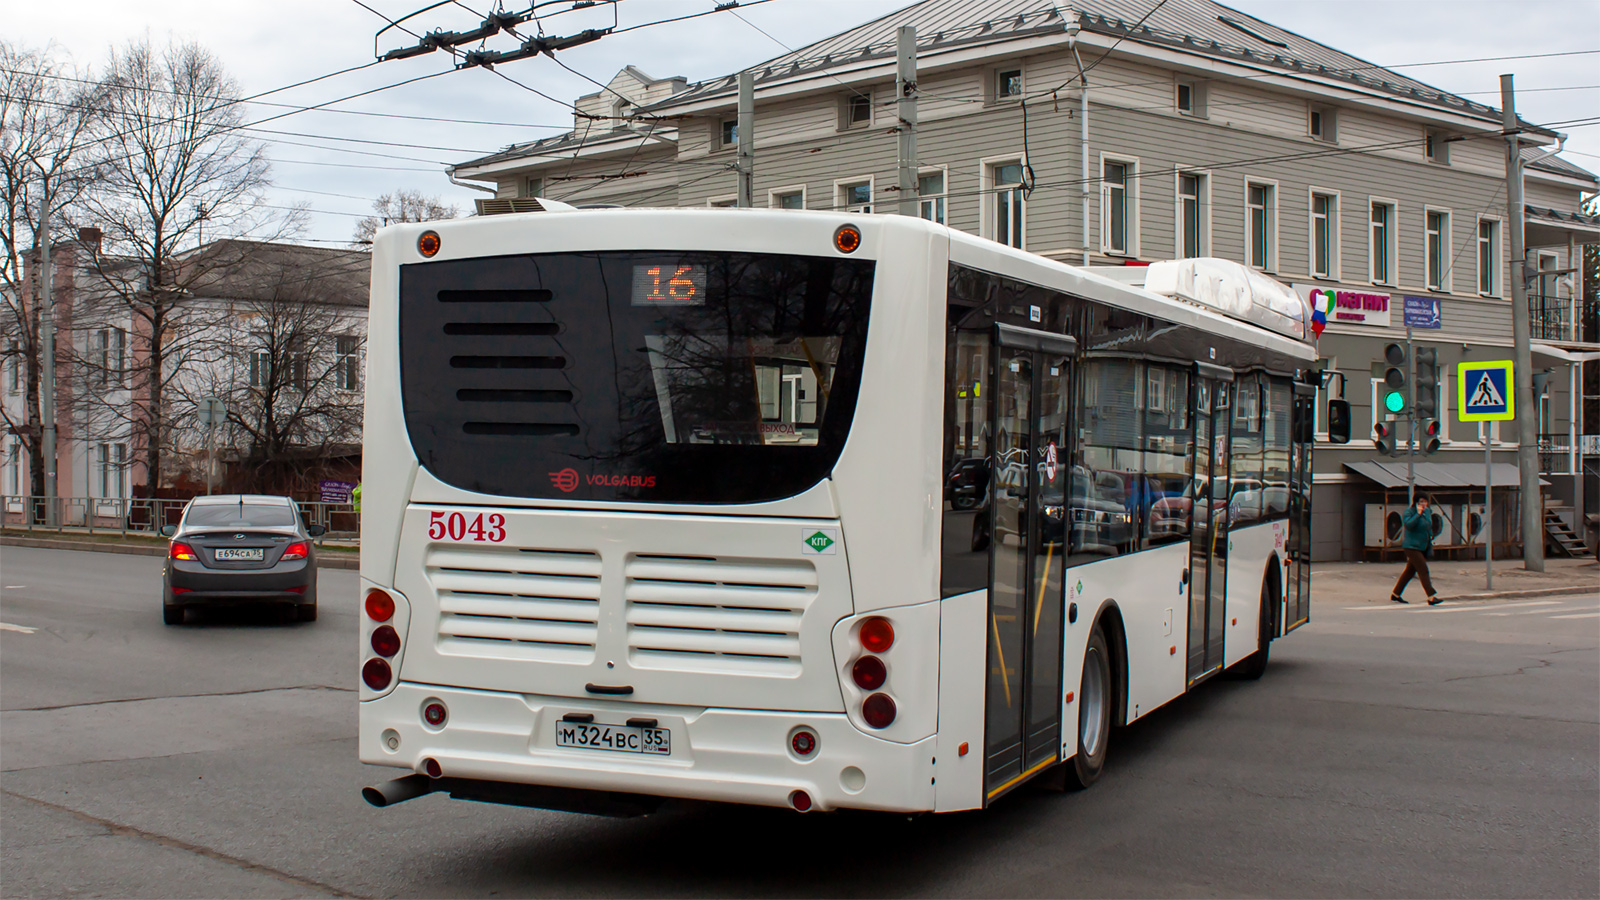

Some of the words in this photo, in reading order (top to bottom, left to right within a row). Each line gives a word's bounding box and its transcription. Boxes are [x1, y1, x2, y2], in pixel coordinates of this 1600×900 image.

[647, 266, 695, 300] 16
[761, 423, 795, 434] ВЫХОД
[586, 474, 656, 487] VOLGABUS
[428, 511, 506, 542] 5043
[811, 537, 828, 546] КПГ
[644, 729, 663, 745] 35
[643, 744, 658, 752] RUS
